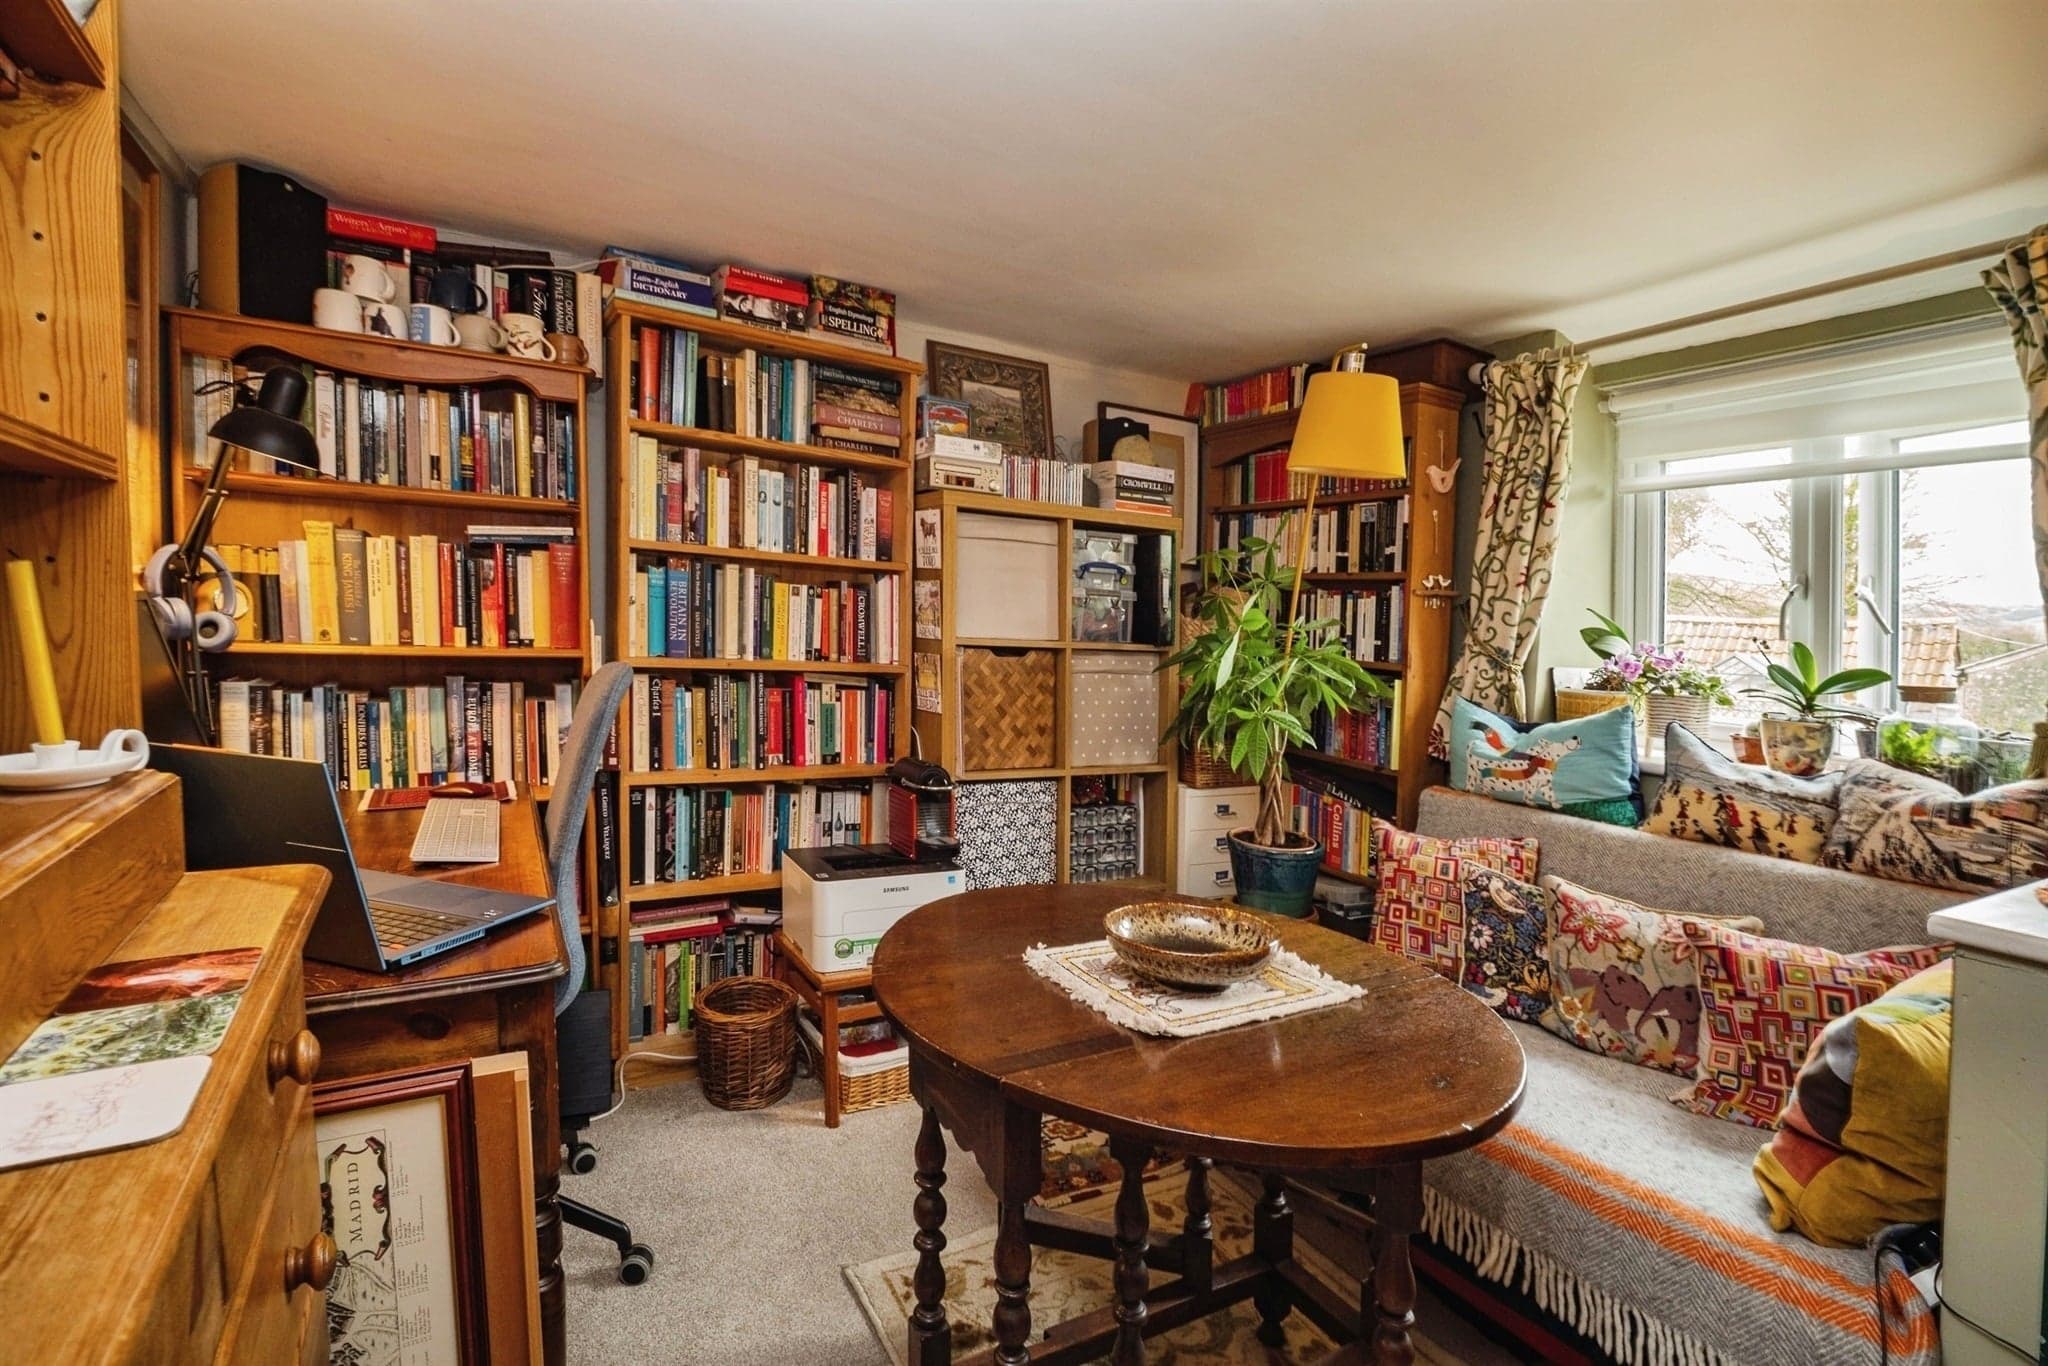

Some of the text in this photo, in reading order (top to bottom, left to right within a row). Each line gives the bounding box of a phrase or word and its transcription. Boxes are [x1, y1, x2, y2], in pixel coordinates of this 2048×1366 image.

[554, 276, 567, 334] STYLE MANUA
[632, 281, 688, 300] DICTIONARY
[565, 299, 575, 334] OXFORD
[828, 315, 878, 338] SPELLING
[837, 415, 879, 431] CHARLES
[834, 440, 870, 451] CHARLES
[342, 552, 353, 577] KING
[341, 579, 354, 609] JAMES
[669, 580, 679, 641] REVOLUTION
[678, 581, 688, 641] BRITAIN IN
[857, 595, 866, 649] CROMWELL
[650, 678, 662, 710] Charles
[357, 704, 369, 740] BONFIRES
[465, 697, 479, 776] EUROPE AT HOME
[1367, 716, 1377, 753] CAESAR
[358, 748, 369, 769] BELLS
[601, 796, 609, 818] GRECO
[1332, 803, 1343, 849] Collins
[882, 885, 910, 894] SAMSUNG
[630, 962, 638, 980] English
[630, 980, 638, 993] Legal
[347, 1161, 363, 1244] MADRID
